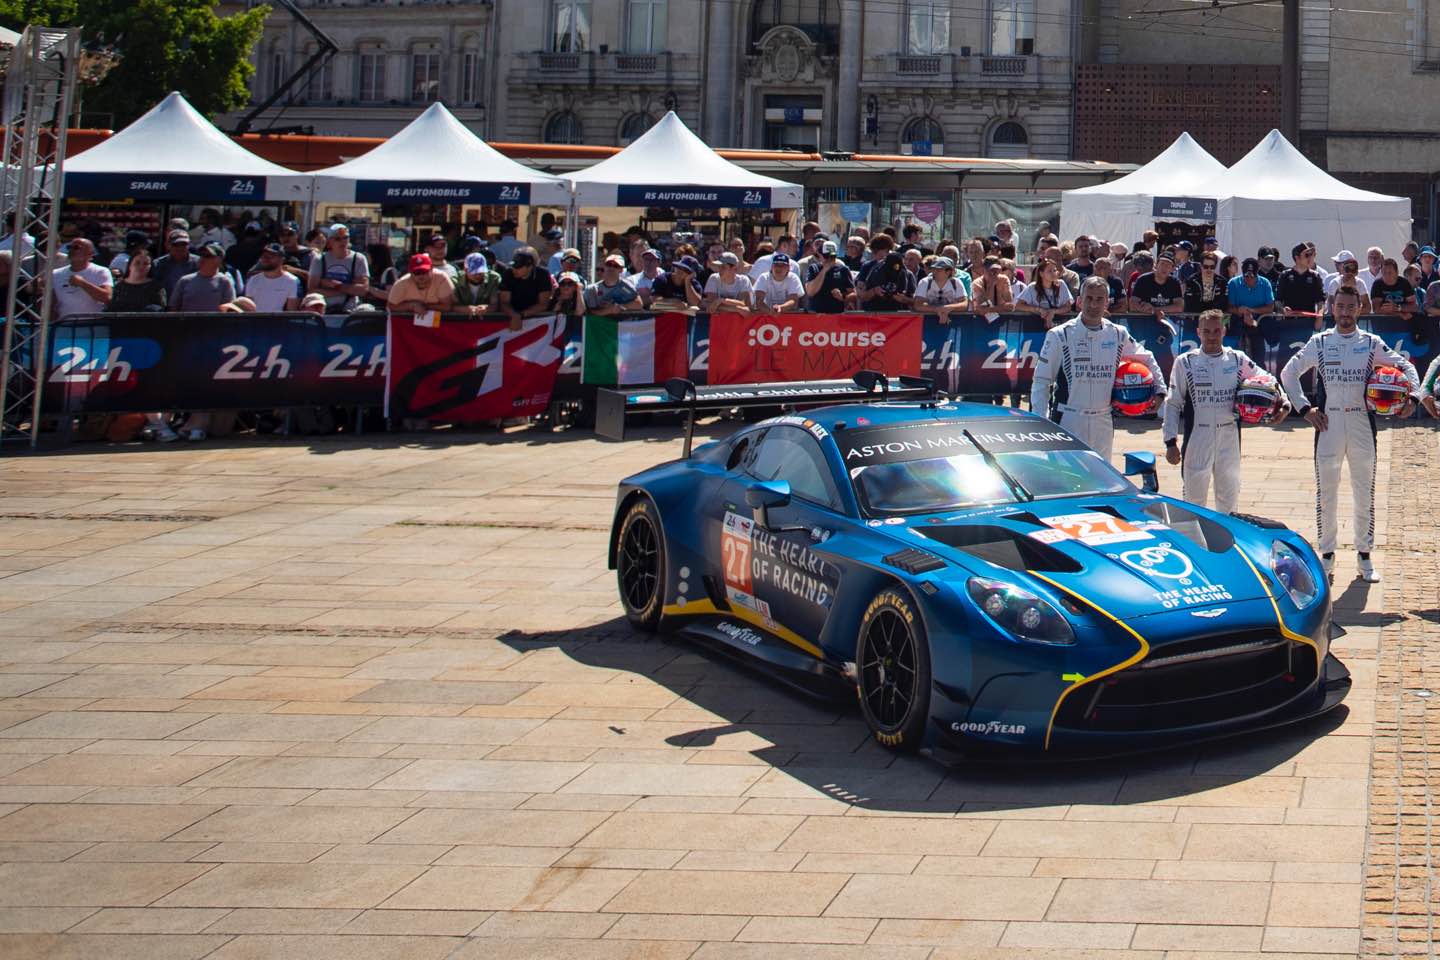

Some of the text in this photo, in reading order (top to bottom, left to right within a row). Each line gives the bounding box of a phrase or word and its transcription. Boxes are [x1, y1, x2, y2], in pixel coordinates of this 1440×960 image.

[130, 182, 168, 190] SPARK
[387, 188, 470, 197] RS AUTOMOBILES
[645, 192, 718, 201] RS AUTOMOBILES
[798, 330, 886, 347] course
[754, 348, 885, 373] LE MANS
[847, 440, 922, 460] ASTON
[1004, 431, 1073, 442] RACING
[1062, 520, 1123, 538] 27
[752, 529, 777, 557] THE
[724, 537, 749, 585] 27
[752, 558, 828, 605] OF RACING
[1153, 584, 1226, 600] THE HEART
[1162, 591, 1232, 608] OF RACING
[951, 721, 1026, 735] GOODYEAR
